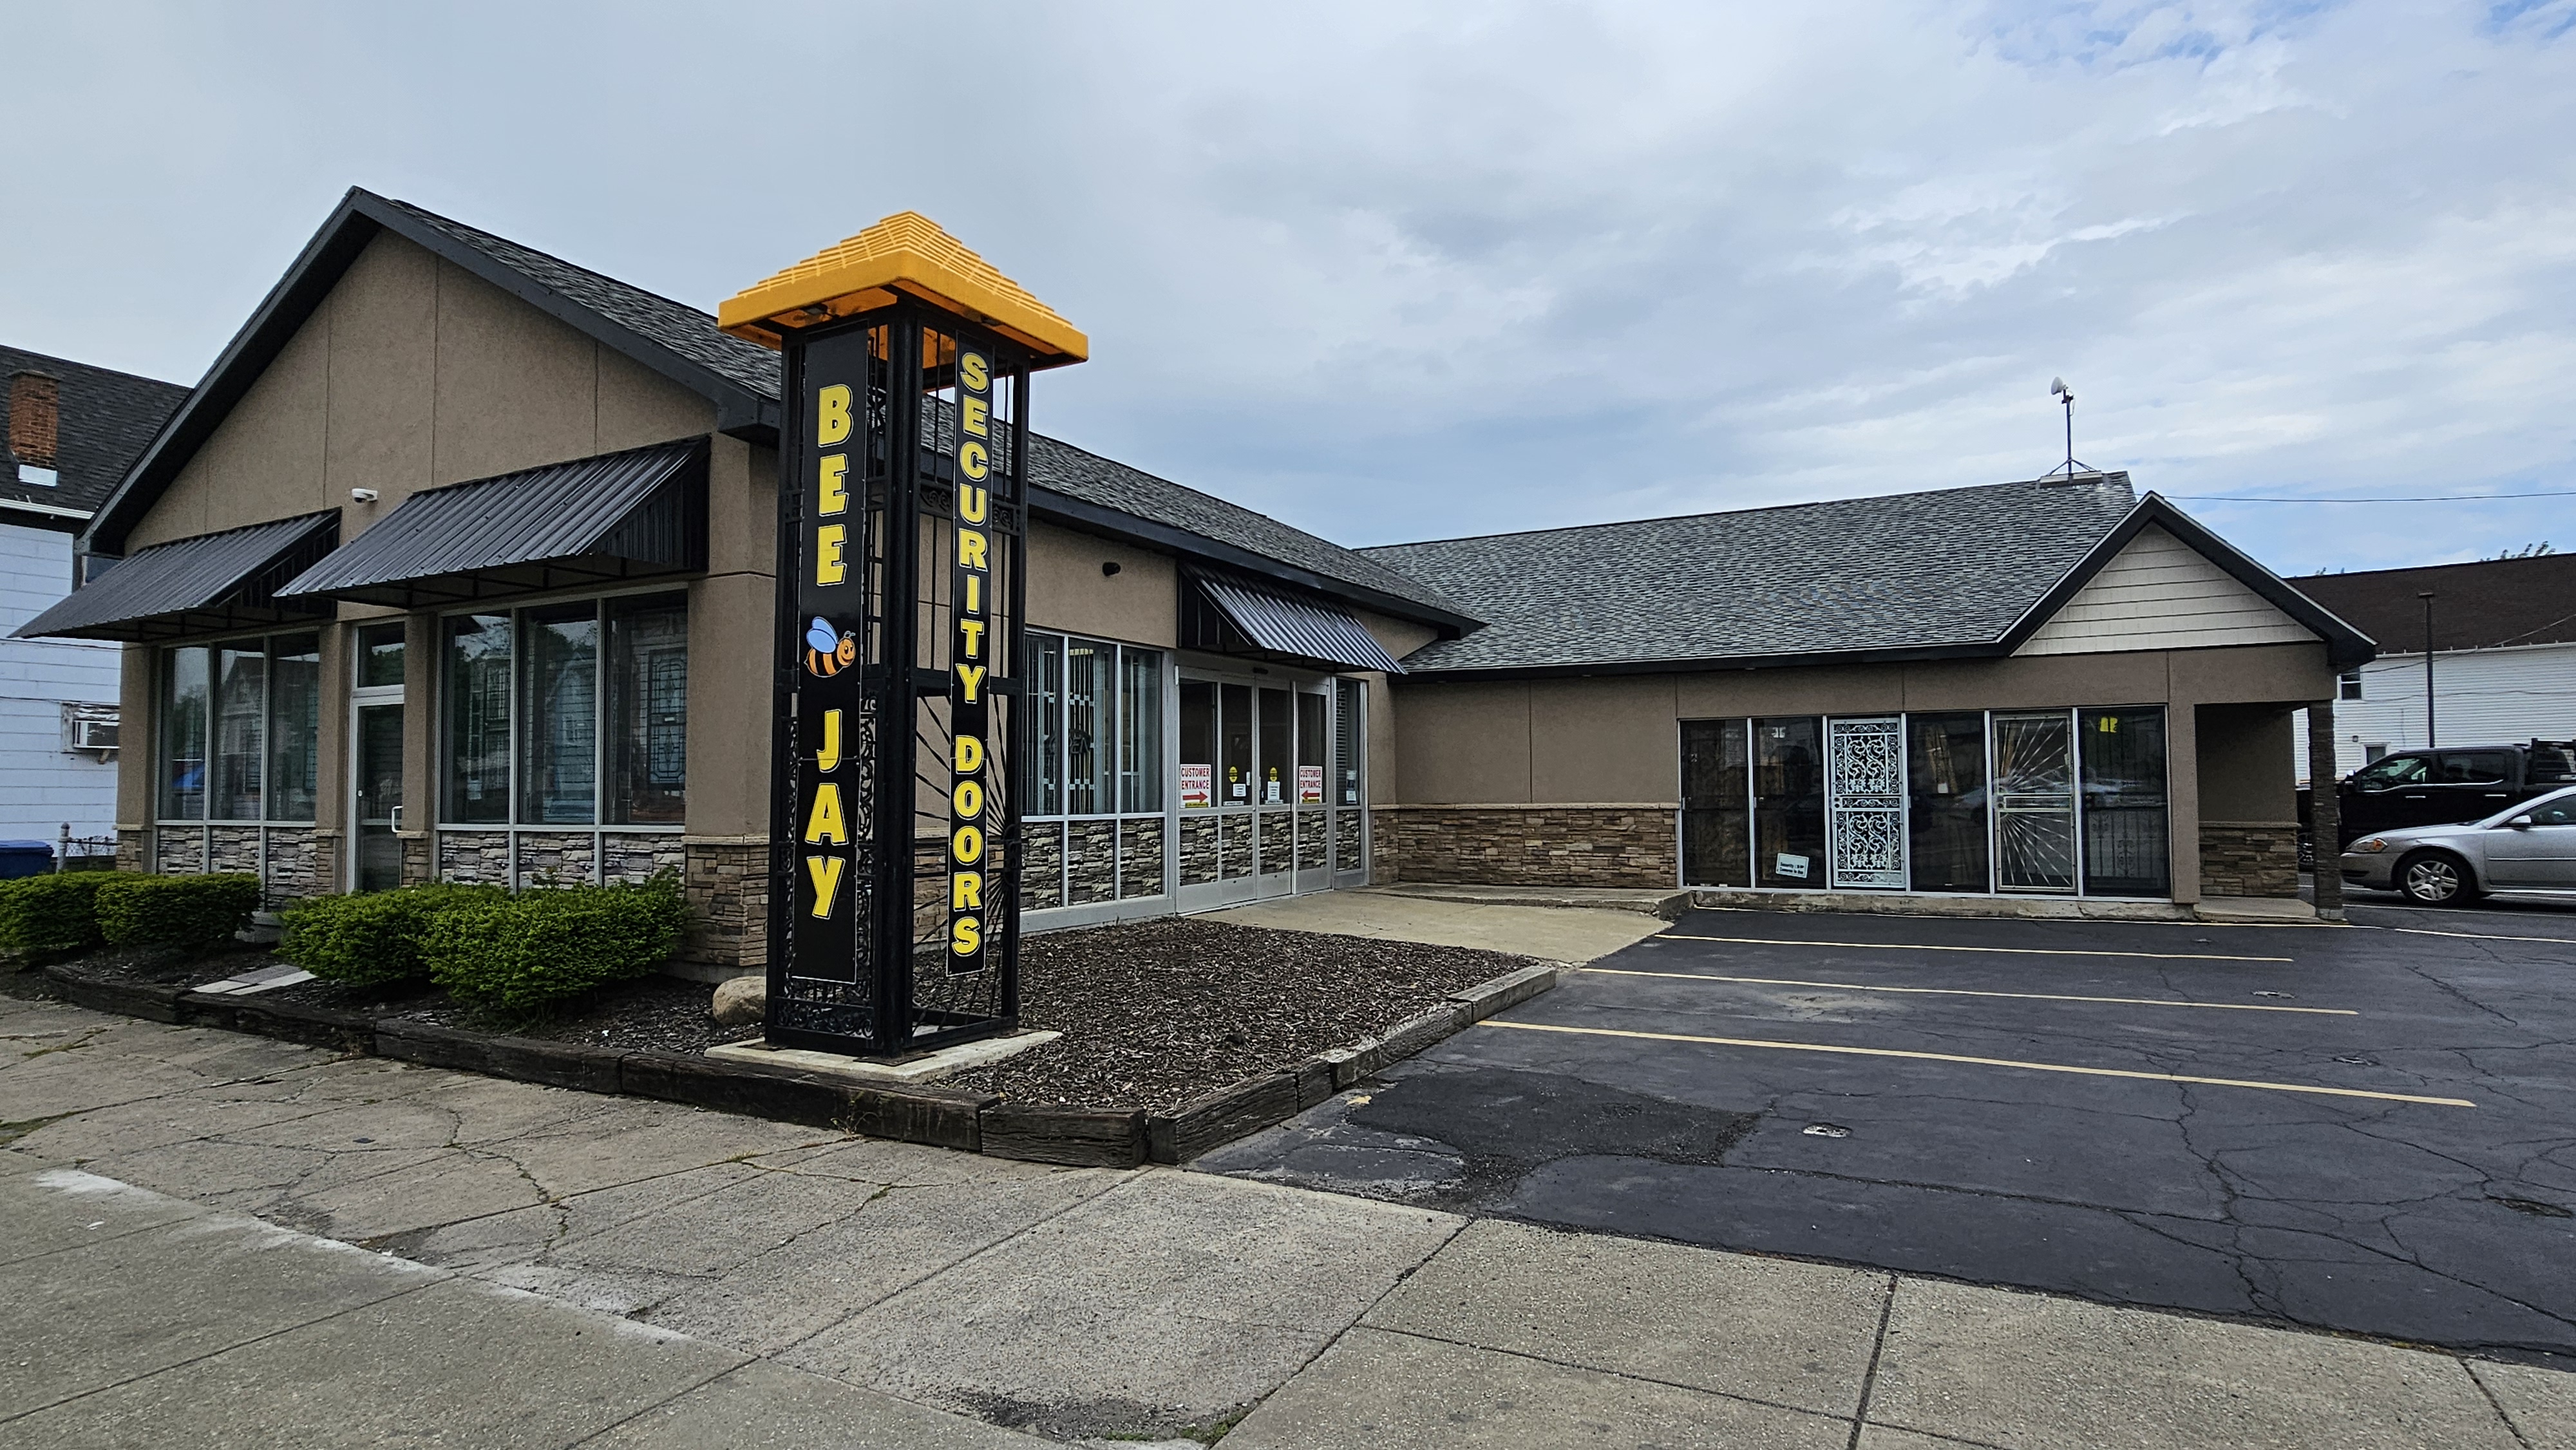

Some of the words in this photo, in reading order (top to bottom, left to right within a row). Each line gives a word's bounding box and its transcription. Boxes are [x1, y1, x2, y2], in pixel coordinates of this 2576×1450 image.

[817, 384, 853, 586] BEE
[956, 352, 989, 704] SECURITY
[805, 709, 848, 919] JAY
[952, 735, 983, 957] DOORS
[1181, 767, 1209, 777] CUSTOMER
[1182, 780, 1209, 790] ENTRANCE
